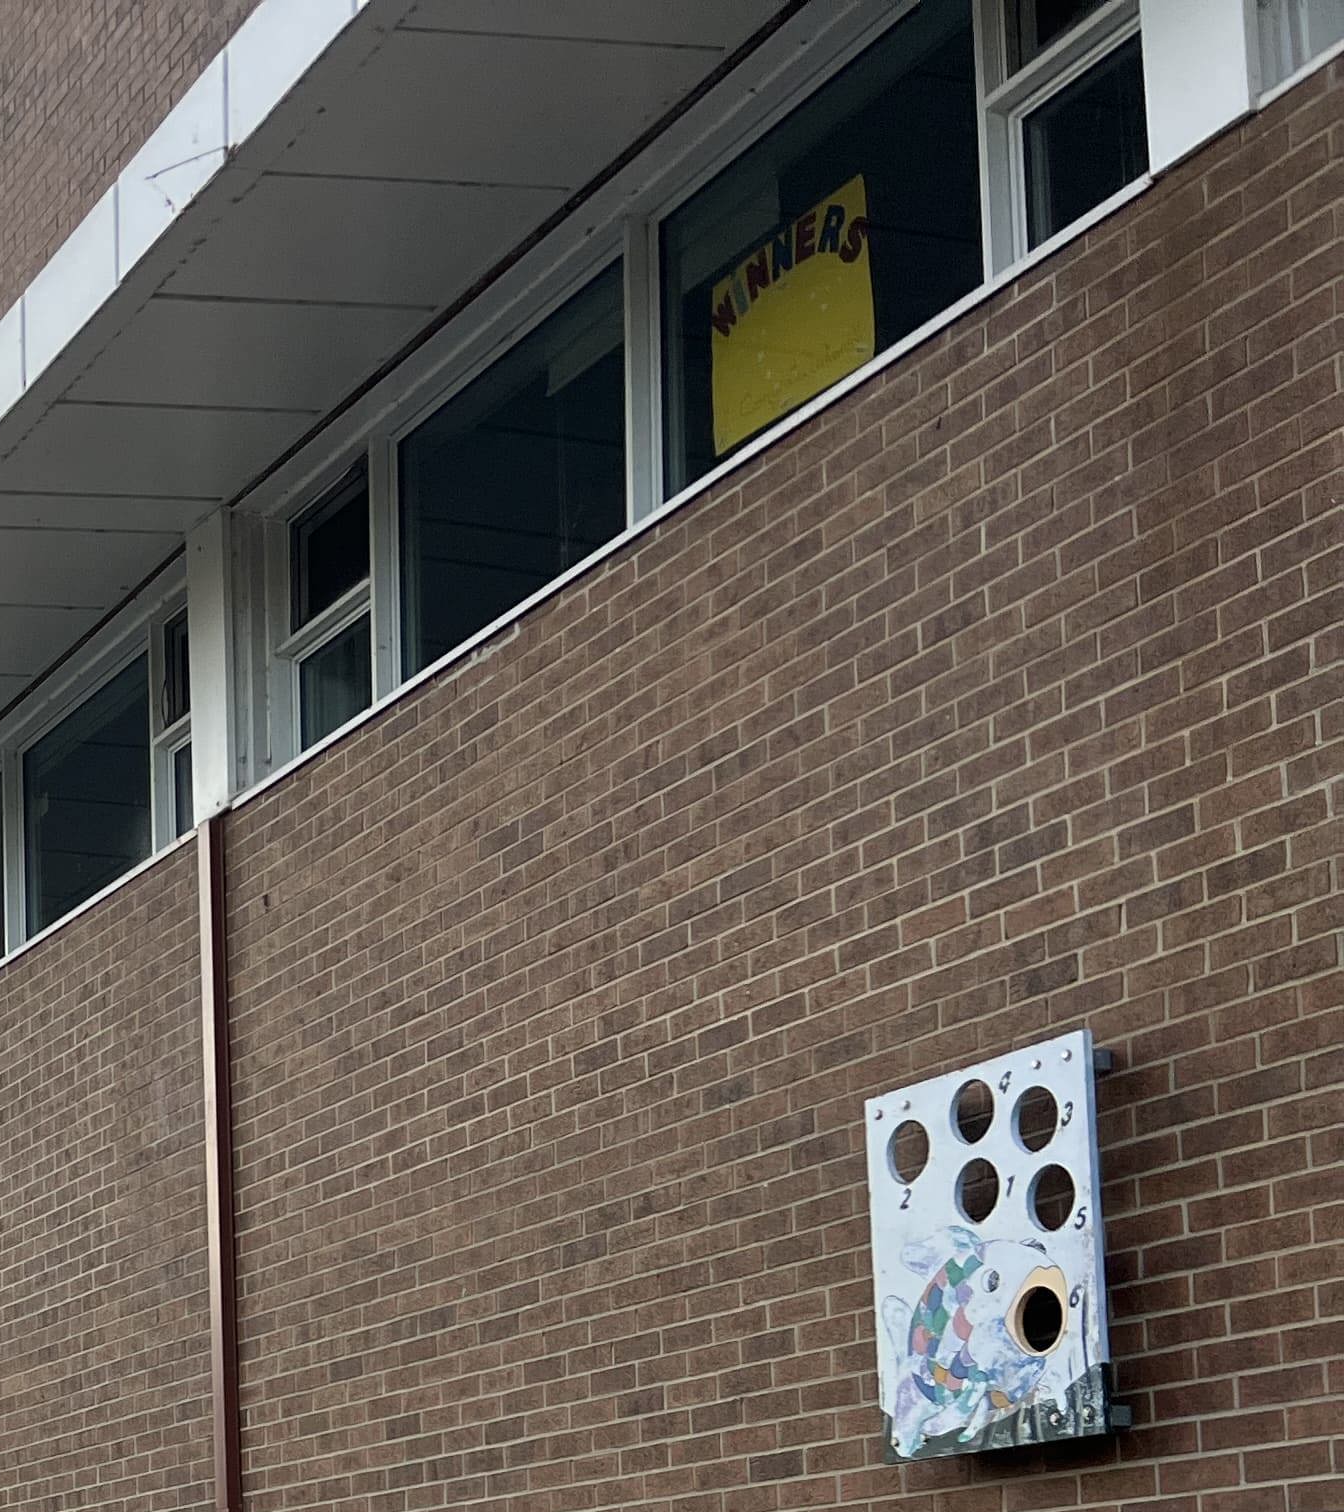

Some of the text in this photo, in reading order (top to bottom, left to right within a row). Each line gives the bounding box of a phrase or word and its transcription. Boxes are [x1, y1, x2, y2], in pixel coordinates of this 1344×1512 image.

[712, 204, 870, 337] WINNERS
[1061, 1101, 1074, 1127] 3
[1006, 1175, 1015, 1197] 1
[900, 1188, 912, 1210] 2
[1074, 1206, 1087, 1230] 5
[1069, 1284, 1083, 1308] 6
